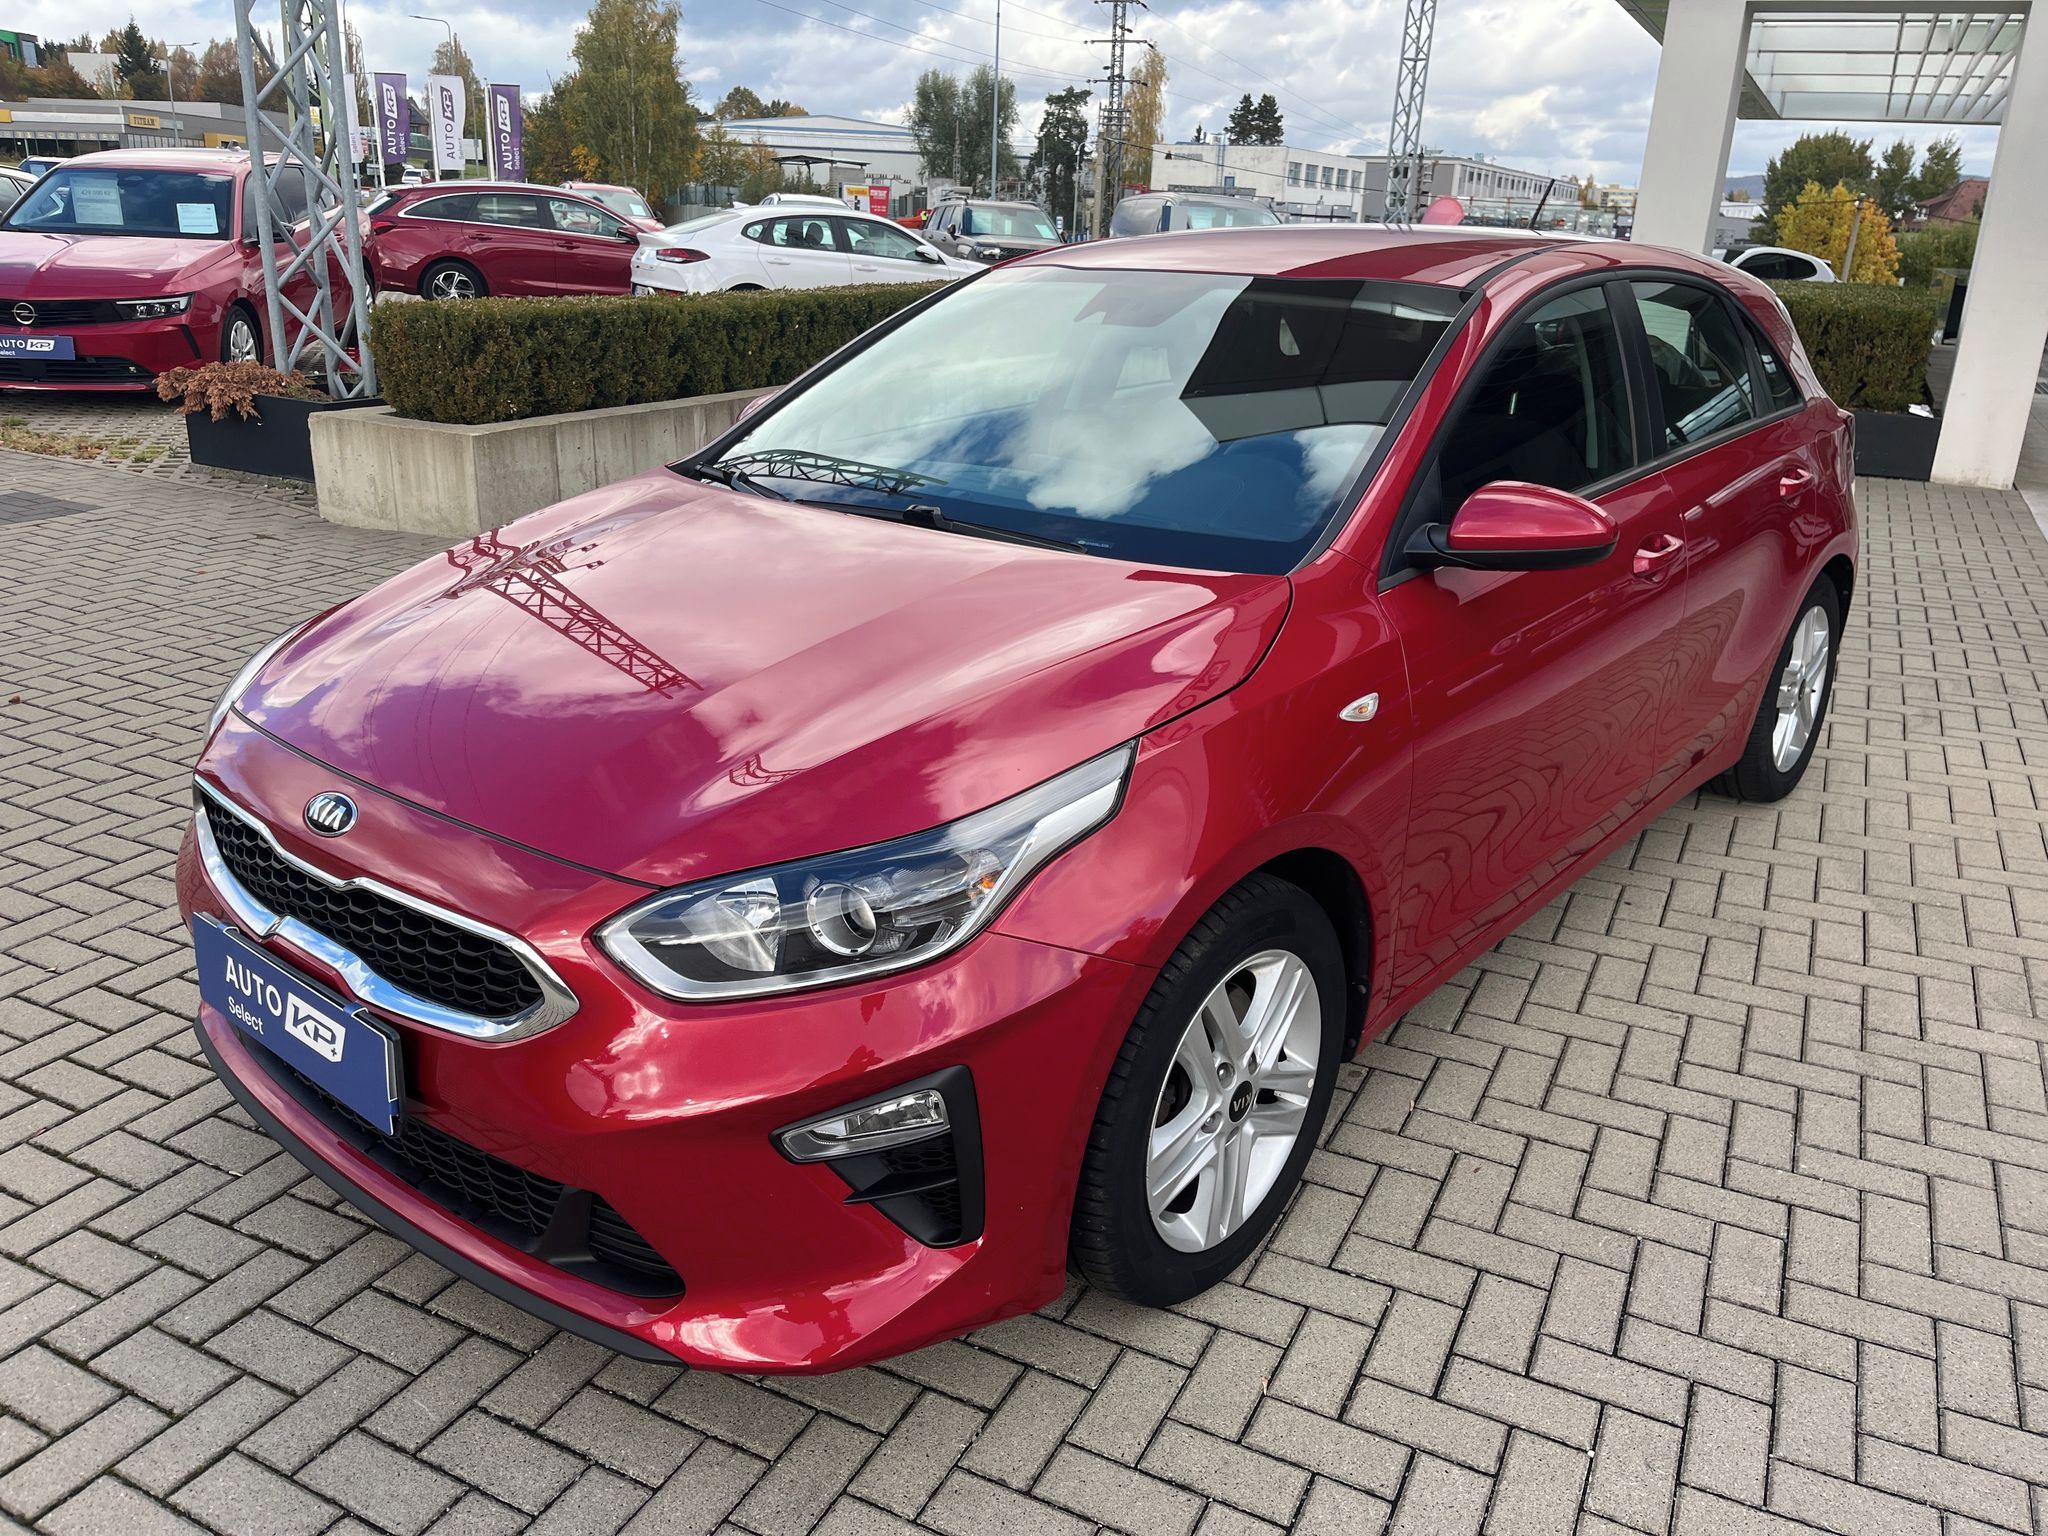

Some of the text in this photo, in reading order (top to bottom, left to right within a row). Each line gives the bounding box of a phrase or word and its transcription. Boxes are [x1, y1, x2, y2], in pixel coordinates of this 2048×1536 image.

[386, 119, 398, 156] AUTO
[399, 132, 407, 155] Select
[444, 123, 456, 160] AUTO
[500, 132, 513, 171] AUTO
[308, 796, 347, 831] KIA
[225, 955, 283, 1018] AUTO
[228, 996, 265, 1036] Select
